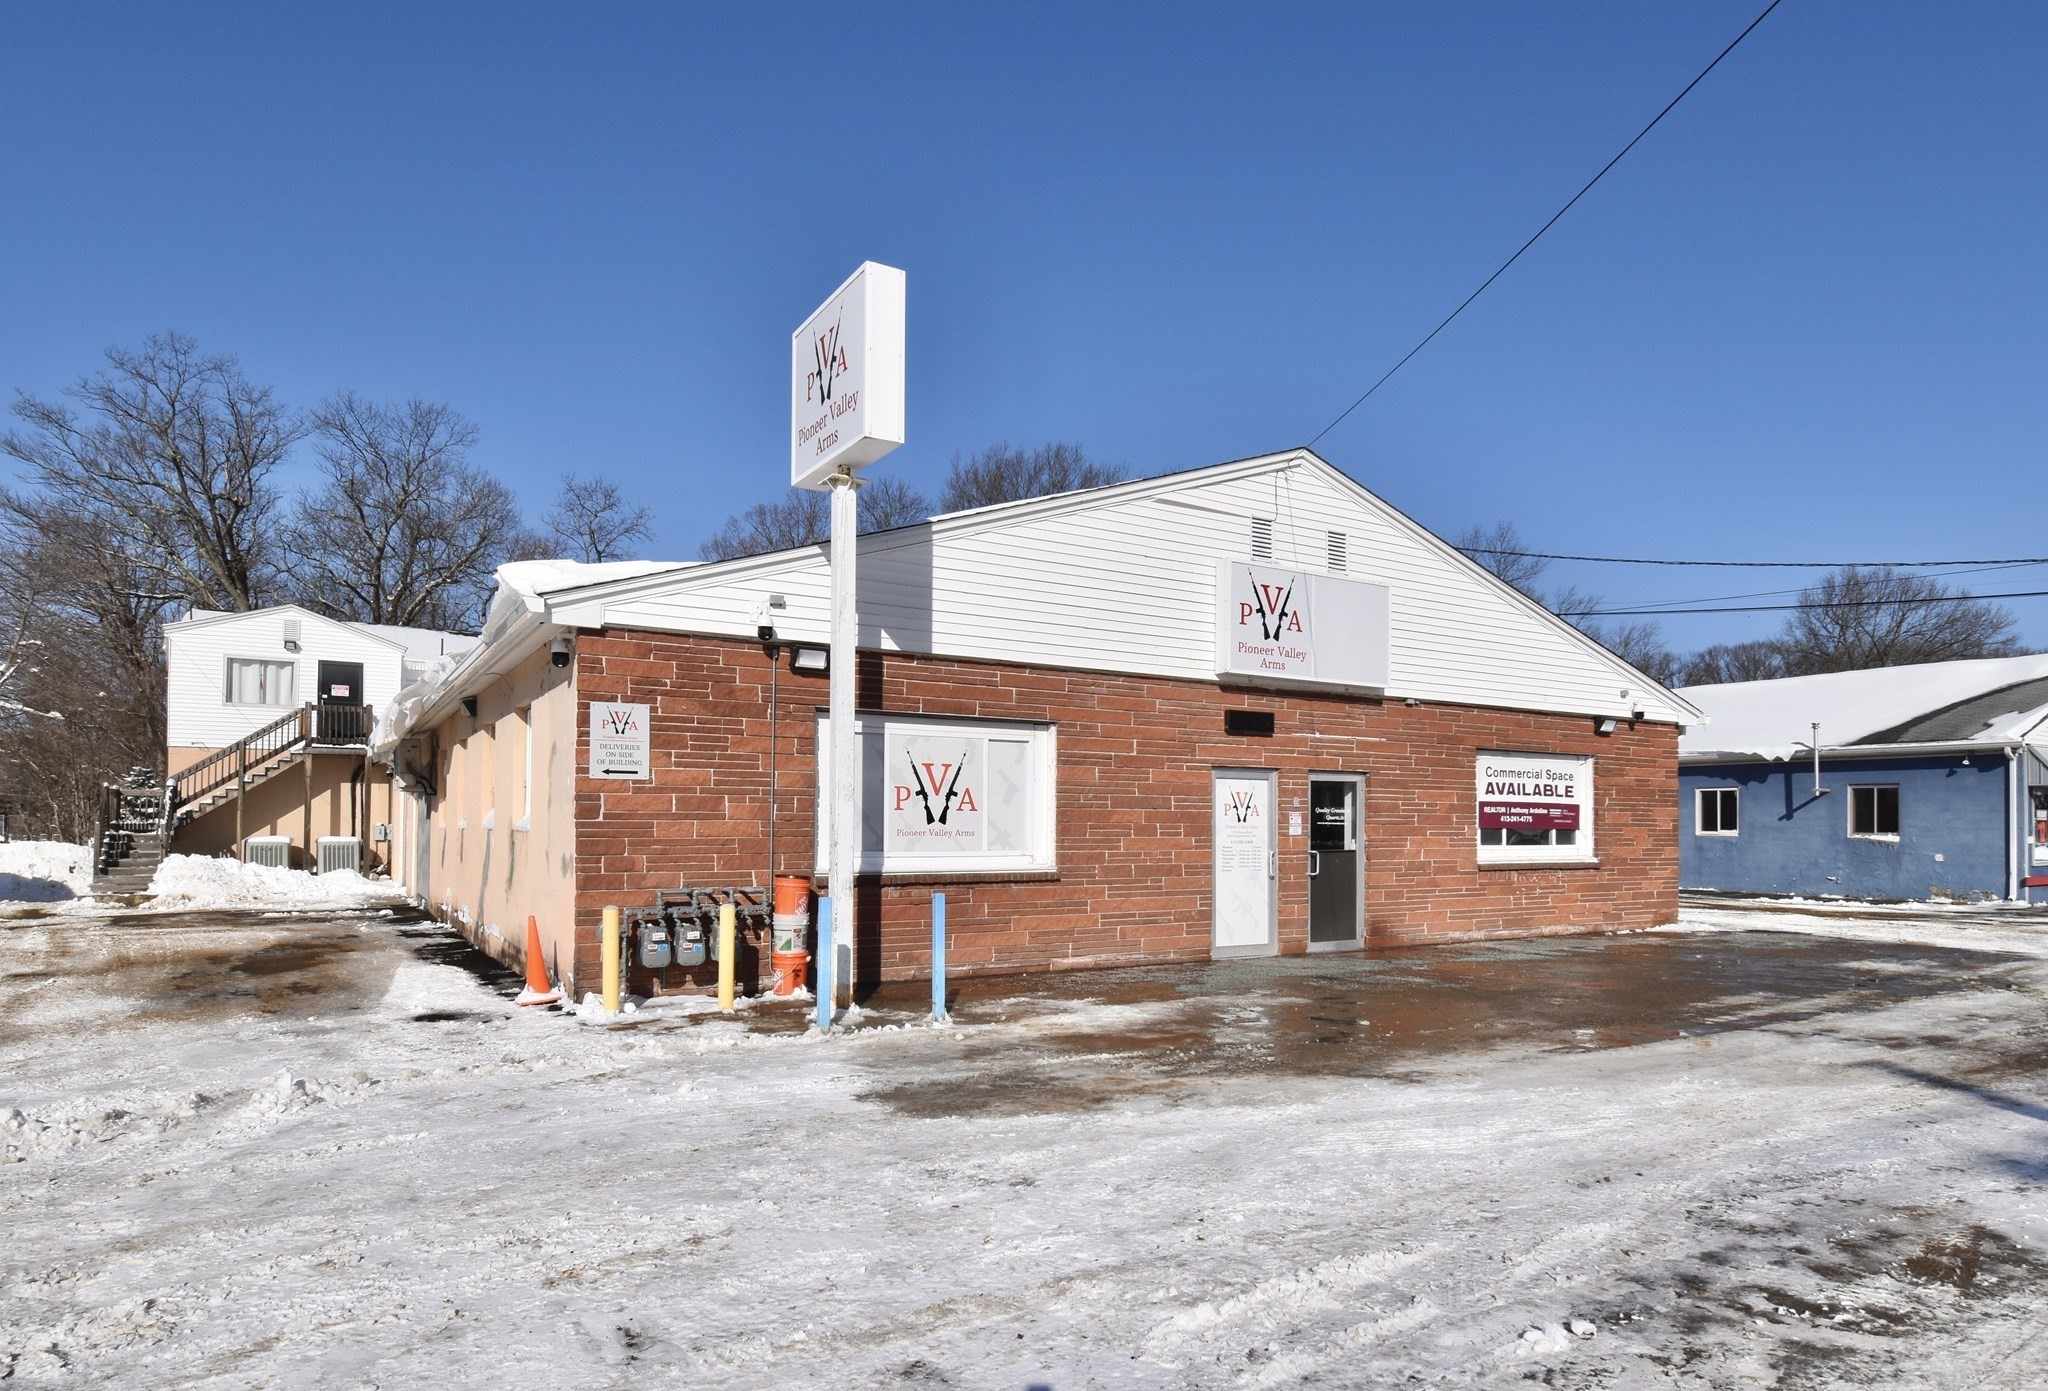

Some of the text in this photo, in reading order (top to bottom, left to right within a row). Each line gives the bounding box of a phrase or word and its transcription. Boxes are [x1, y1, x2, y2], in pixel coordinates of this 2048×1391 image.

[798, 390, 859, 447] Pioneer Valley
[815, 429, 839, 456] Arms
[1238, 641, 1307, 663] Pioneer Valley
[1260, 658, 1286, 671] Arms
[1485, 766, 1574, 782] Commercial Space
[1485, 782, 1574, 798] AVAILABLE
[1483, 806, 1506, 814] REALTOR
[897, 828, 975, 839] Pioneer Valley Arms
